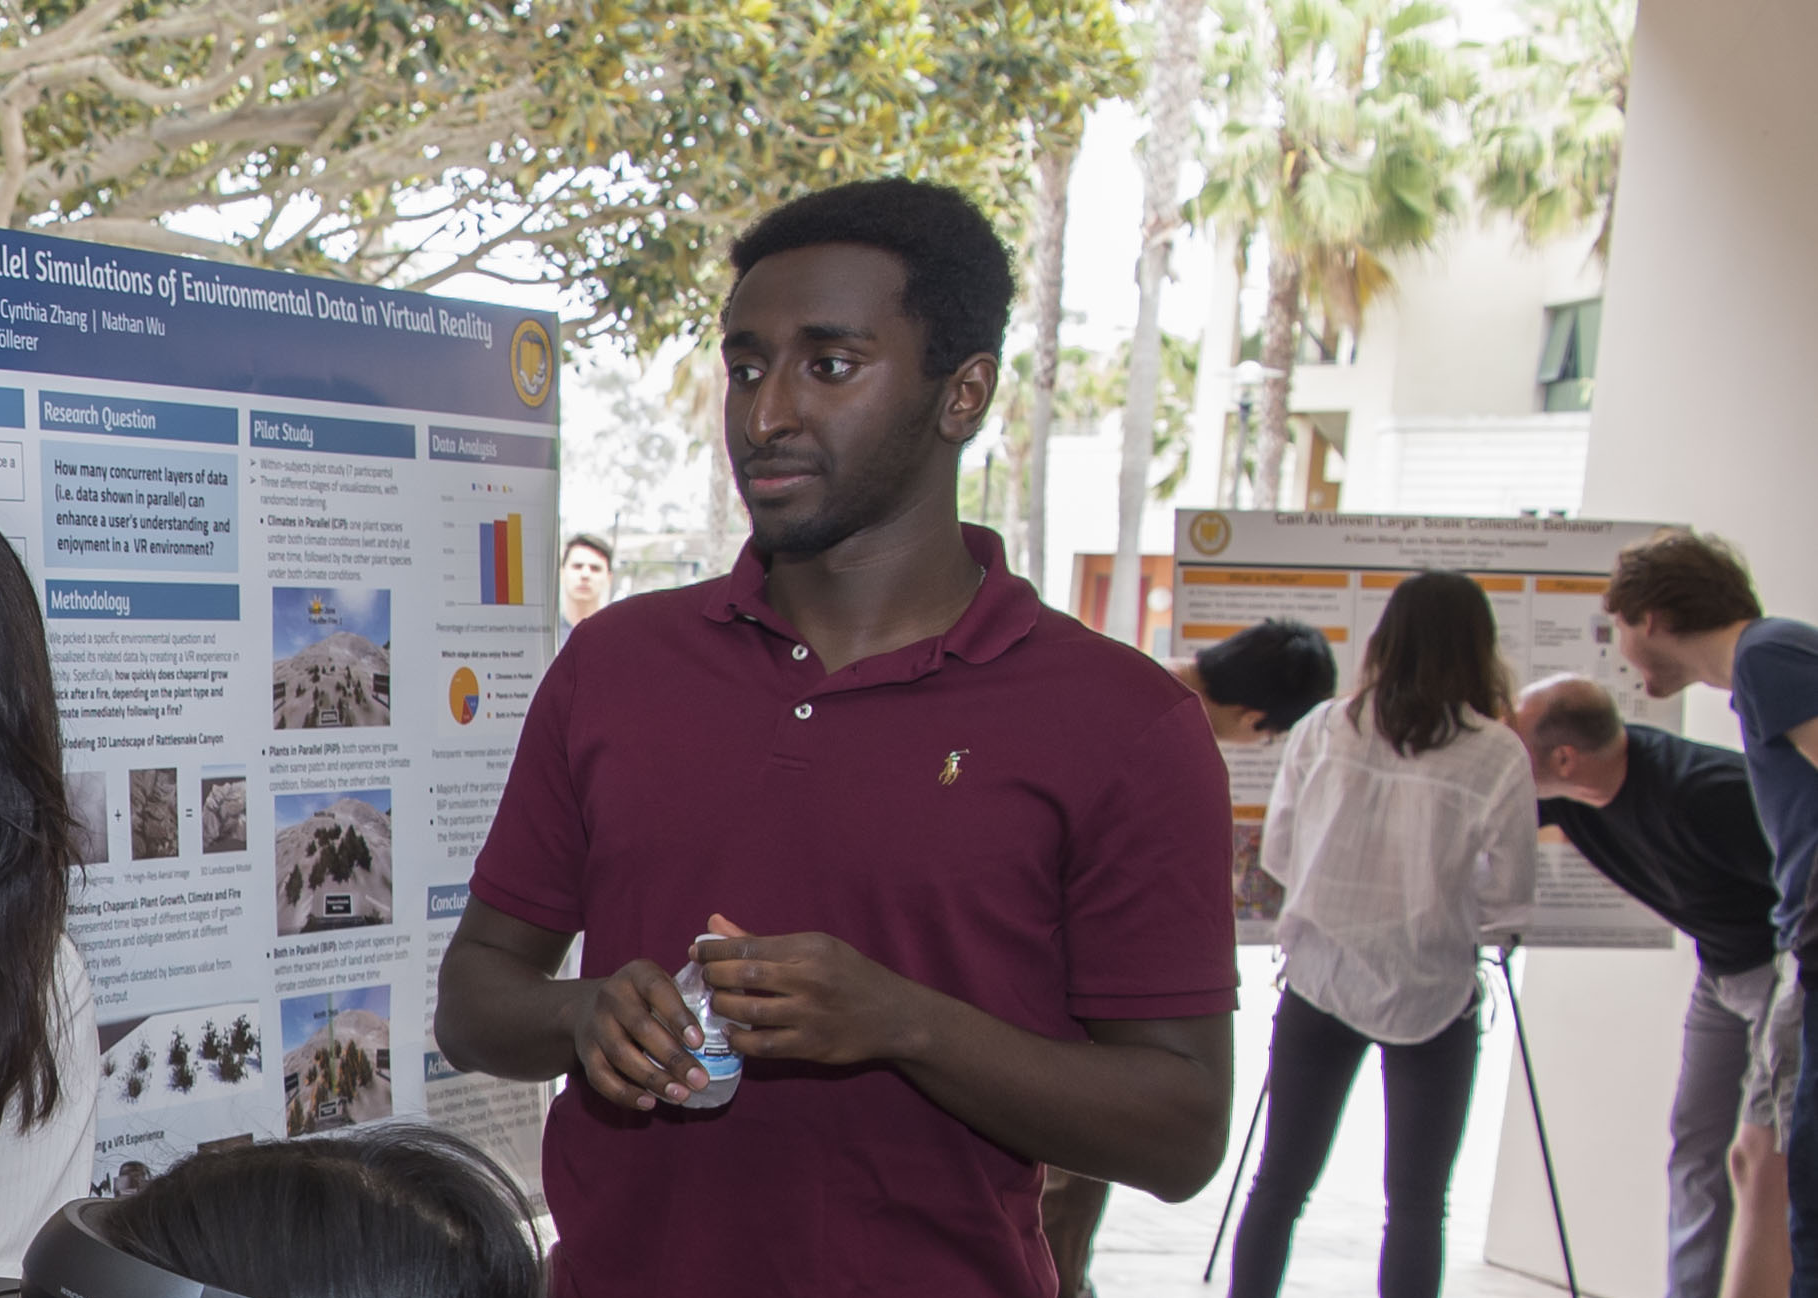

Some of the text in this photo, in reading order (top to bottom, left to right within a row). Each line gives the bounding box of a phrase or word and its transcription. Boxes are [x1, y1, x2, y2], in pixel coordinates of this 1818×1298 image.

[35, 250, 153, 297] Simulations
[158, 269, 177, 306] of
[182, 271, 314, 318] Environmental
[318, 291, 358, 324] Data
[361, 297, 377, 326] in
[378, 300, 436, 334] Virtual
[439, 309, 492, 350] Reality
[0, 299, 47, 324] Cynthia
[50, 304, 87, 332] Zhang
[102, 311, 144, 334] Nathan
[146, 316, 165, 336] Wu
[44, 401, 156, 431] Research Question
[254, 420, 314, 448] Pilot Study
[432, 435, 497, 461] Data Analysis
[9, 459, 15, 468] a
[55, 460, 228, 485] How many concurrent layers of data
[55, 484, 204, 508] (i.e. data shown in parallel) can
[56, 511, 230, 536] enhance a user's understanding and
[268, 515, 296, 527] Climates
[298, 517, 303, 527] in
[305, 517, 330, 528] Parallel
[1275, 513, 1303, 525] Can
[1378, 516, 1417, 531] Large
[1424, 517, 1462, 529] Scale
[1468, 518, 1537, 531] Collective
[1543, 519, 1614, 534] Behavior?
[57, 535, 214, 556] enjoyment in a VR environment?
[51, 590, 130, 616] Methodology
[49, 632, 215, 646] We picked a specific environmental question and
[87, 651, 239, 665] its related data by creating a VR experience in
[73, 668, 228, 683] Specifically, how quickly does chaparral grow
[56, 687, 223, 701] ack after a fire, depending on the plant type and
[81, 705, 182, 719] immediately following a fire?
[62, 733, 223, 752] Modeling 3D Landscape of Rattlesnake Canyon
[269, 745, 289, 757] Plants
[291, 745, 296, 755] in
[298, 744, 322, 755] Parallel
[68, 888, 241, 916] Modeling Chaparral: Plant Growth, Climate and Fire
[274, 947, 287, 959] Both
[289, 946, 294, 955] in
[296, 944, 319, 955] Parallel
[108, 1139, 112, 1149] a
[114, 1136, 124, 1147] VR
[126, 1130, 164, 1145] Experience
